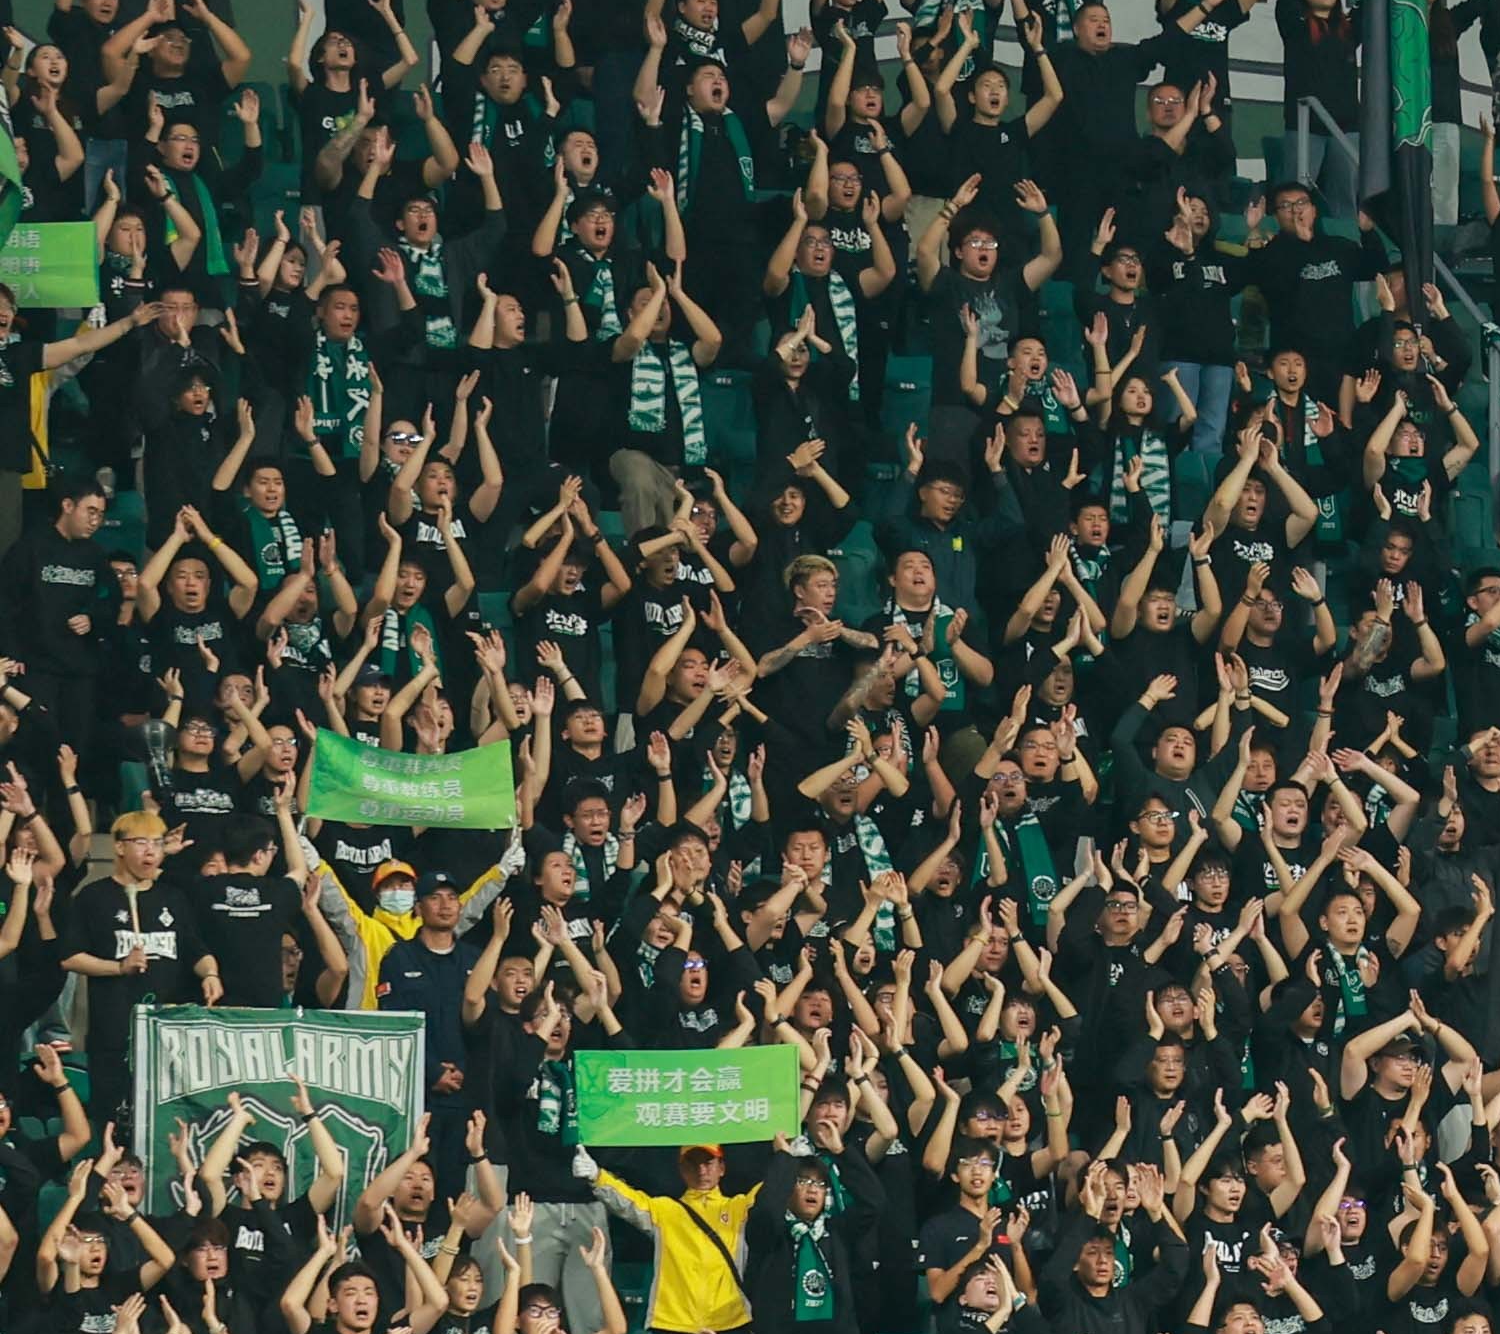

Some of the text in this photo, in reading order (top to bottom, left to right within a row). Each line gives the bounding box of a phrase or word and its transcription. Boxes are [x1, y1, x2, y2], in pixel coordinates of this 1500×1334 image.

[606, 1064, 744, 1096] 爱拼才会赢
[633, 1097, 772, 1129] 观赛要文明
